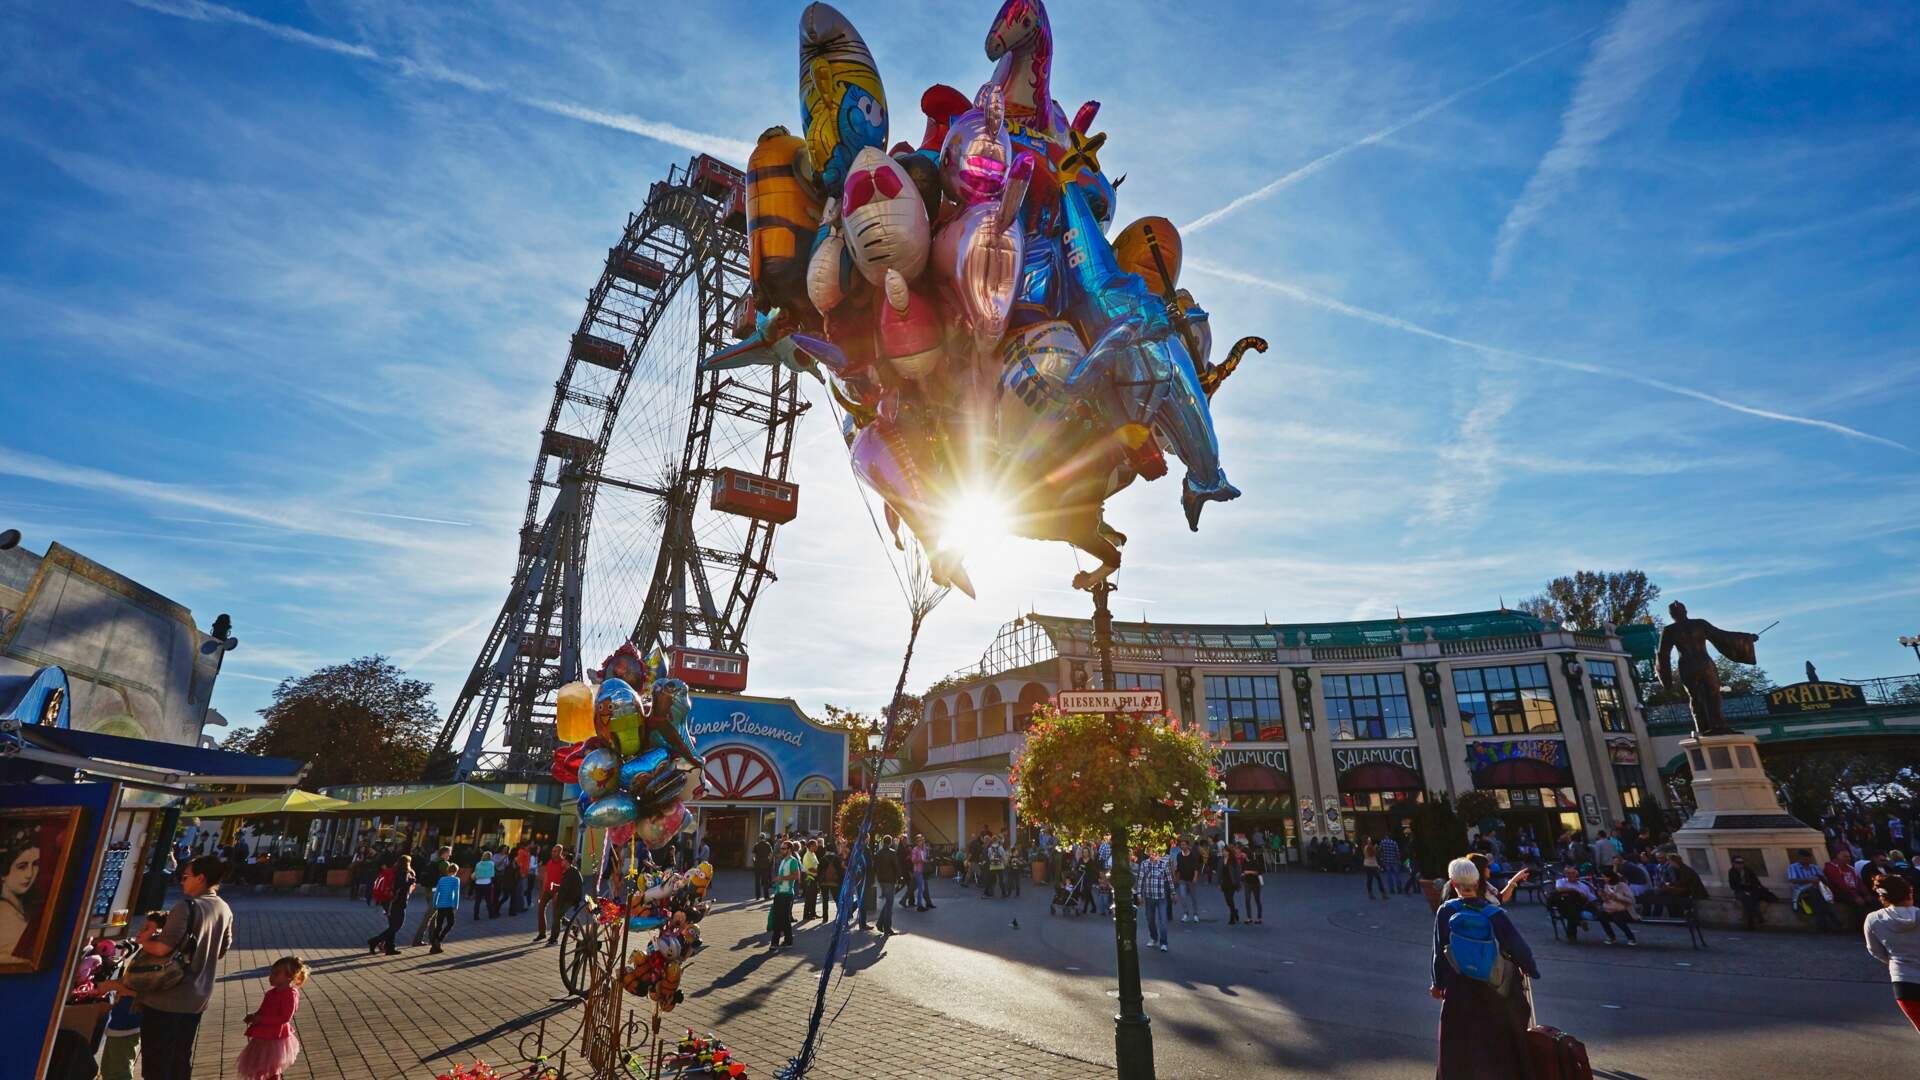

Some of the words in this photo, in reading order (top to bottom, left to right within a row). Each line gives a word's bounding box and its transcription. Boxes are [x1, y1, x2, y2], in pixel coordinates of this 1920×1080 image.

[1063, 695, 1160, 708] RIESENRADPLATZ
[1771, 683, 1856, 704] PRATER
[687, 717, 730, 735] iener
[730, 711, 804, 747] Riesenrad
[1215, 750, 1288, 773] SALAMUCCI
[1336, 748, 1418, 772] SALAMUCCI
